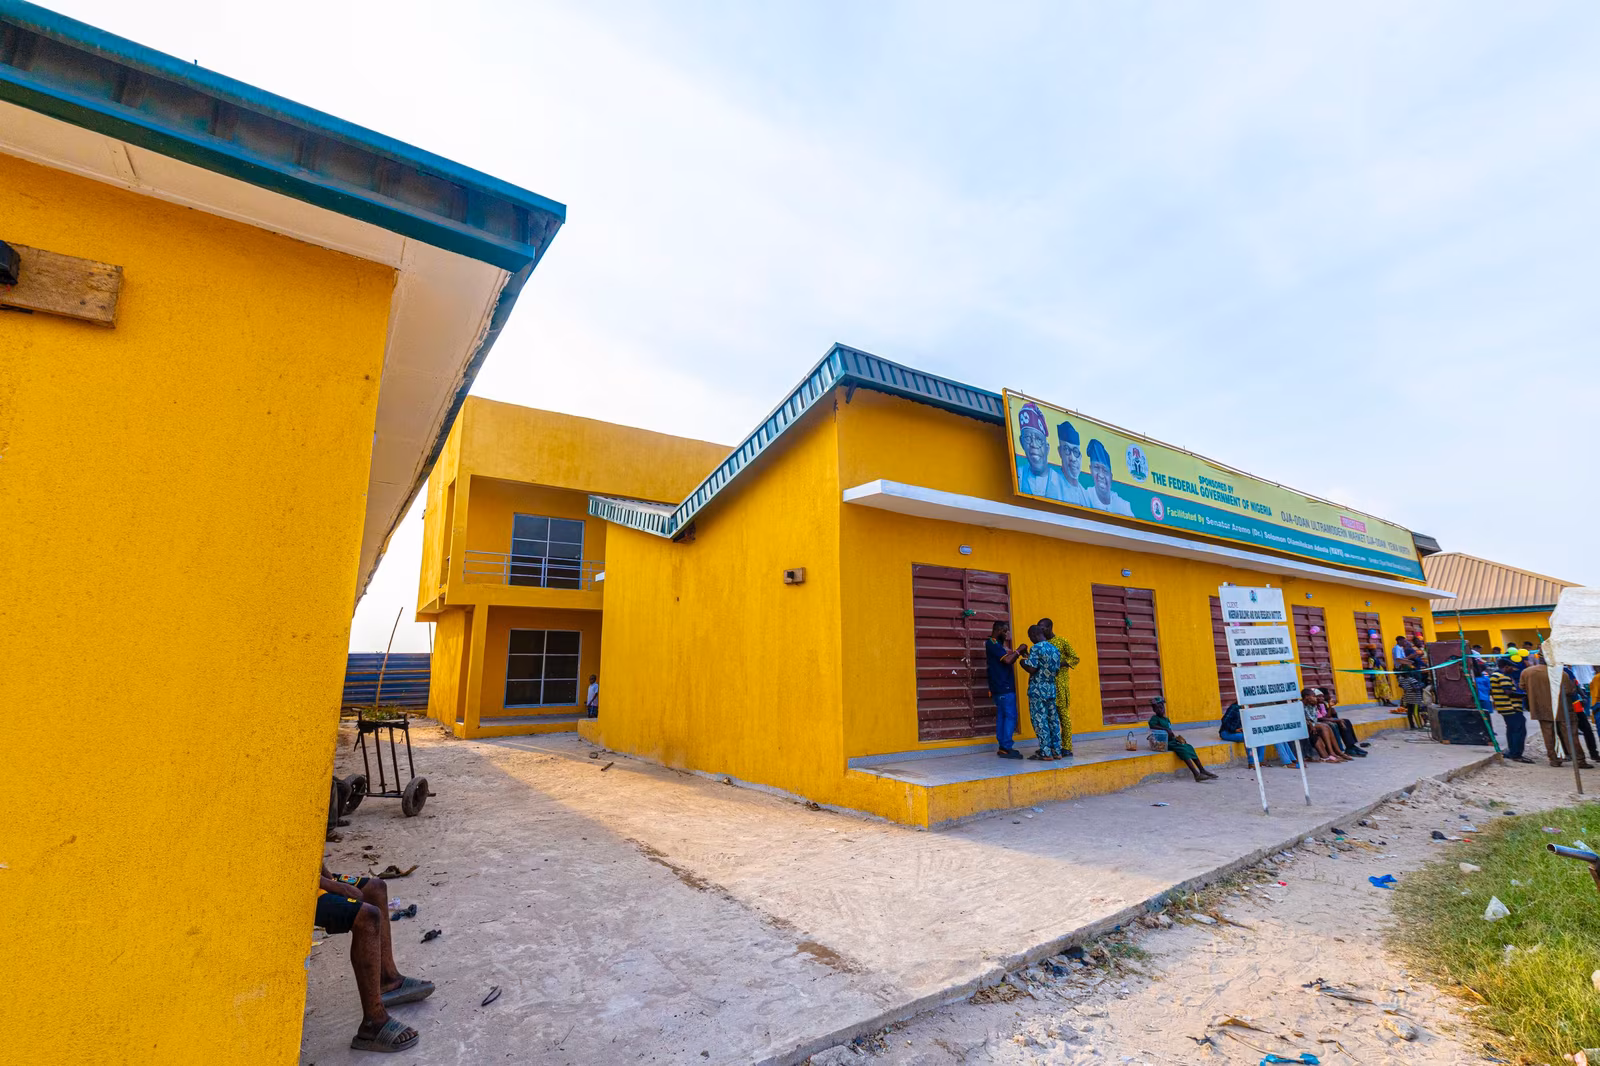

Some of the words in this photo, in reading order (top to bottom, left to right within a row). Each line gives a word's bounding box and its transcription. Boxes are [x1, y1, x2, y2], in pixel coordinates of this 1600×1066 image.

[1151, 471, 1167, 487] THE
[1168, 476, 1199, 495] FEDERAL
[1200, 486, 1241, 507] GOVERNMENT
[1242, 499, 1250, 510] OF
[1250, 501, 1272, 516] NIGERIA
[1198, 475, 1228, 493] SPONSORED
[1228, 485, 1234, 494] BY
[1167, 507, 1197, 521] Facilitated
[1198, 514, 1205, 525] By
[1205, 517, 1230, 529] Senator
[1231, 523, 1251, 534] Aremo
[1264, 532, 1286, 543] Solomon
[1281, 511, 1310, 528] OJA-ODAN
[1311, 520, 1348, 538] ULTRAMODERN
[1348, 530, 1366, 543] MARKET
